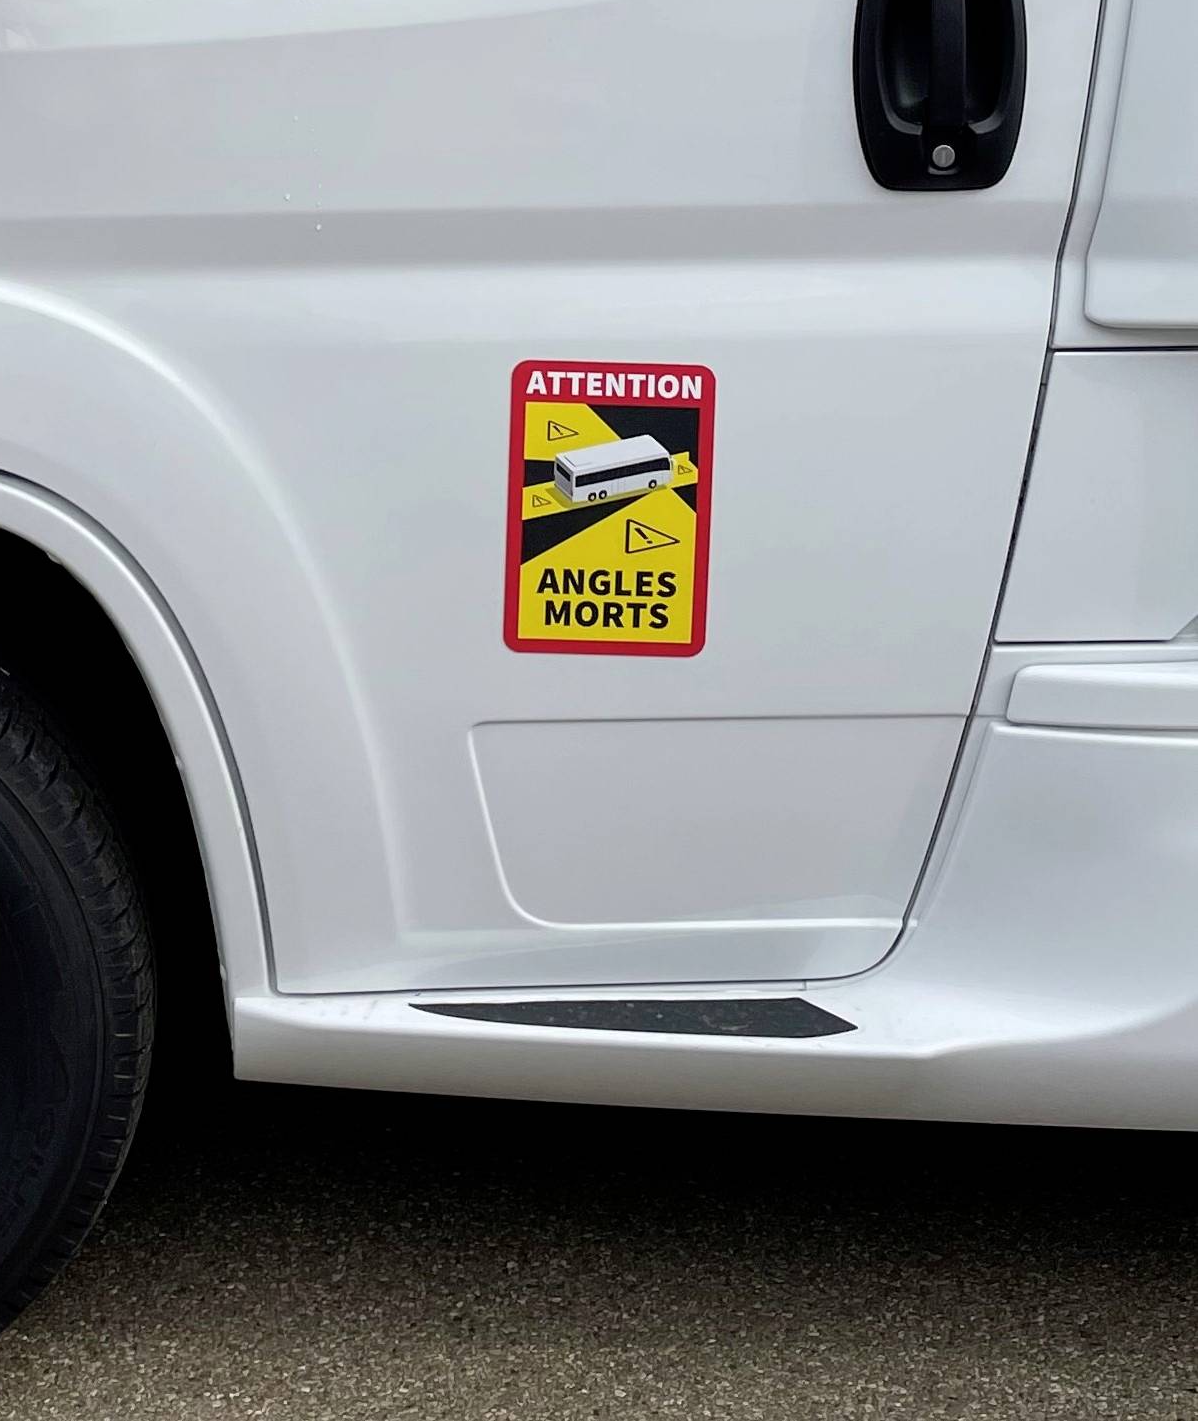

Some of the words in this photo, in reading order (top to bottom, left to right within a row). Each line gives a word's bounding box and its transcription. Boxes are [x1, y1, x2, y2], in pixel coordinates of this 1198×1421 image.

[526, 370, 702, 399] ATTENTION
[536, 567, 677, 597] ANGLES
[544, 600, 669, 629] MORTS
